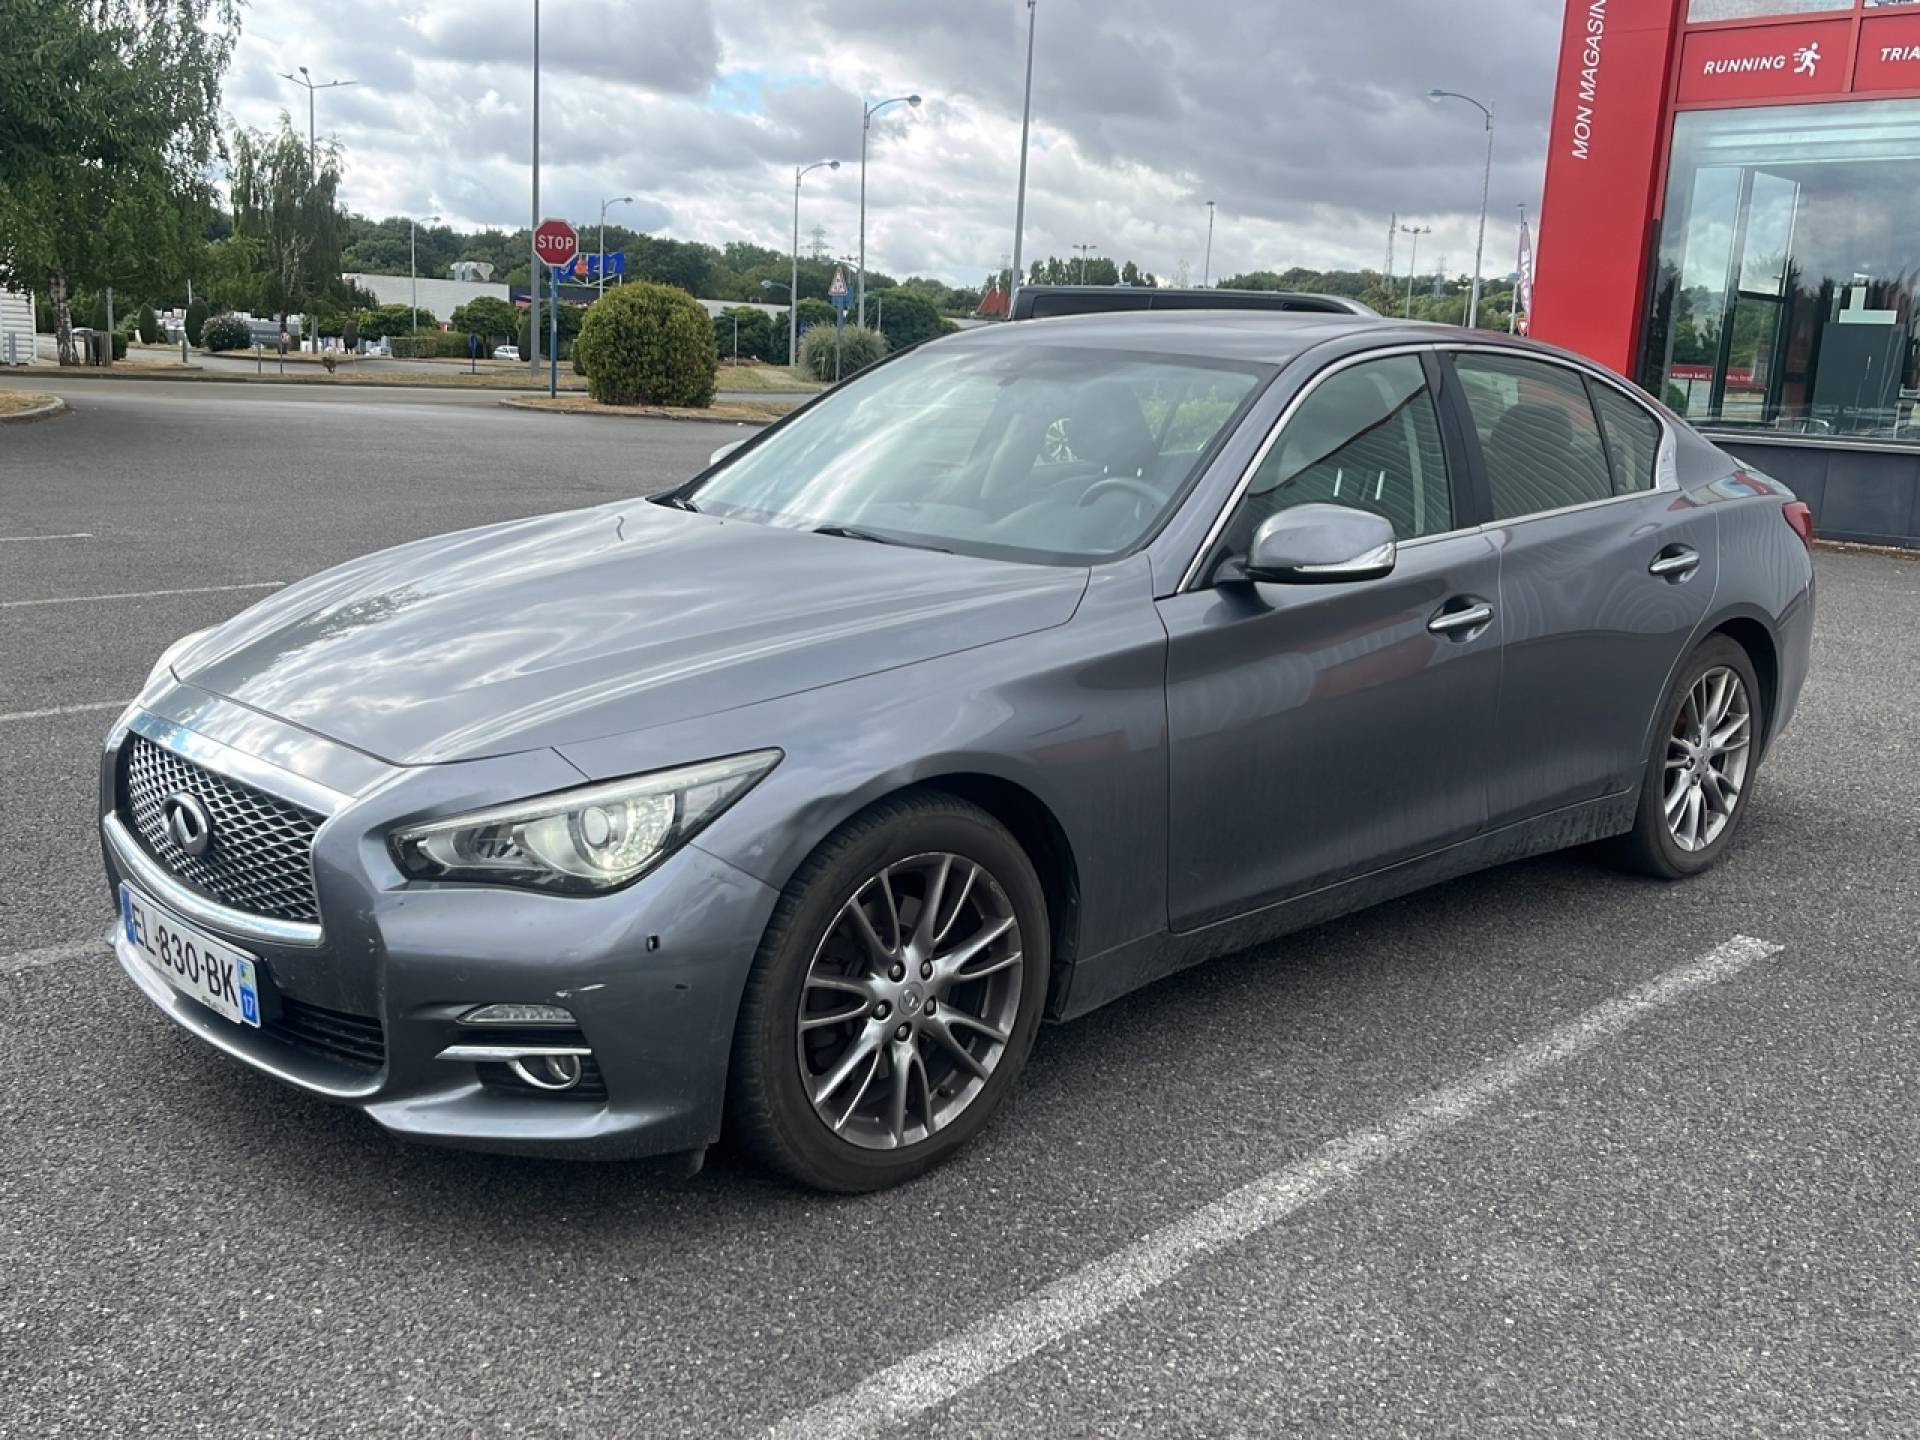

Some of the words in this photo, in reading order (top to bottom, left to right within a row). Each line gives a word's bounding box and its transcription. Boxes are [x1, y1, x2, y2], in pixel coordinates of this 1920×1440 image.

[1703, 55, 1786, 75] RUNNING
[1572, 105, 1593, 160] MON
[537, 235, 574, 250] STOP
[132, 903, 239, 1008] EL-830-BK
[243, 994, 253, 1017] 17
